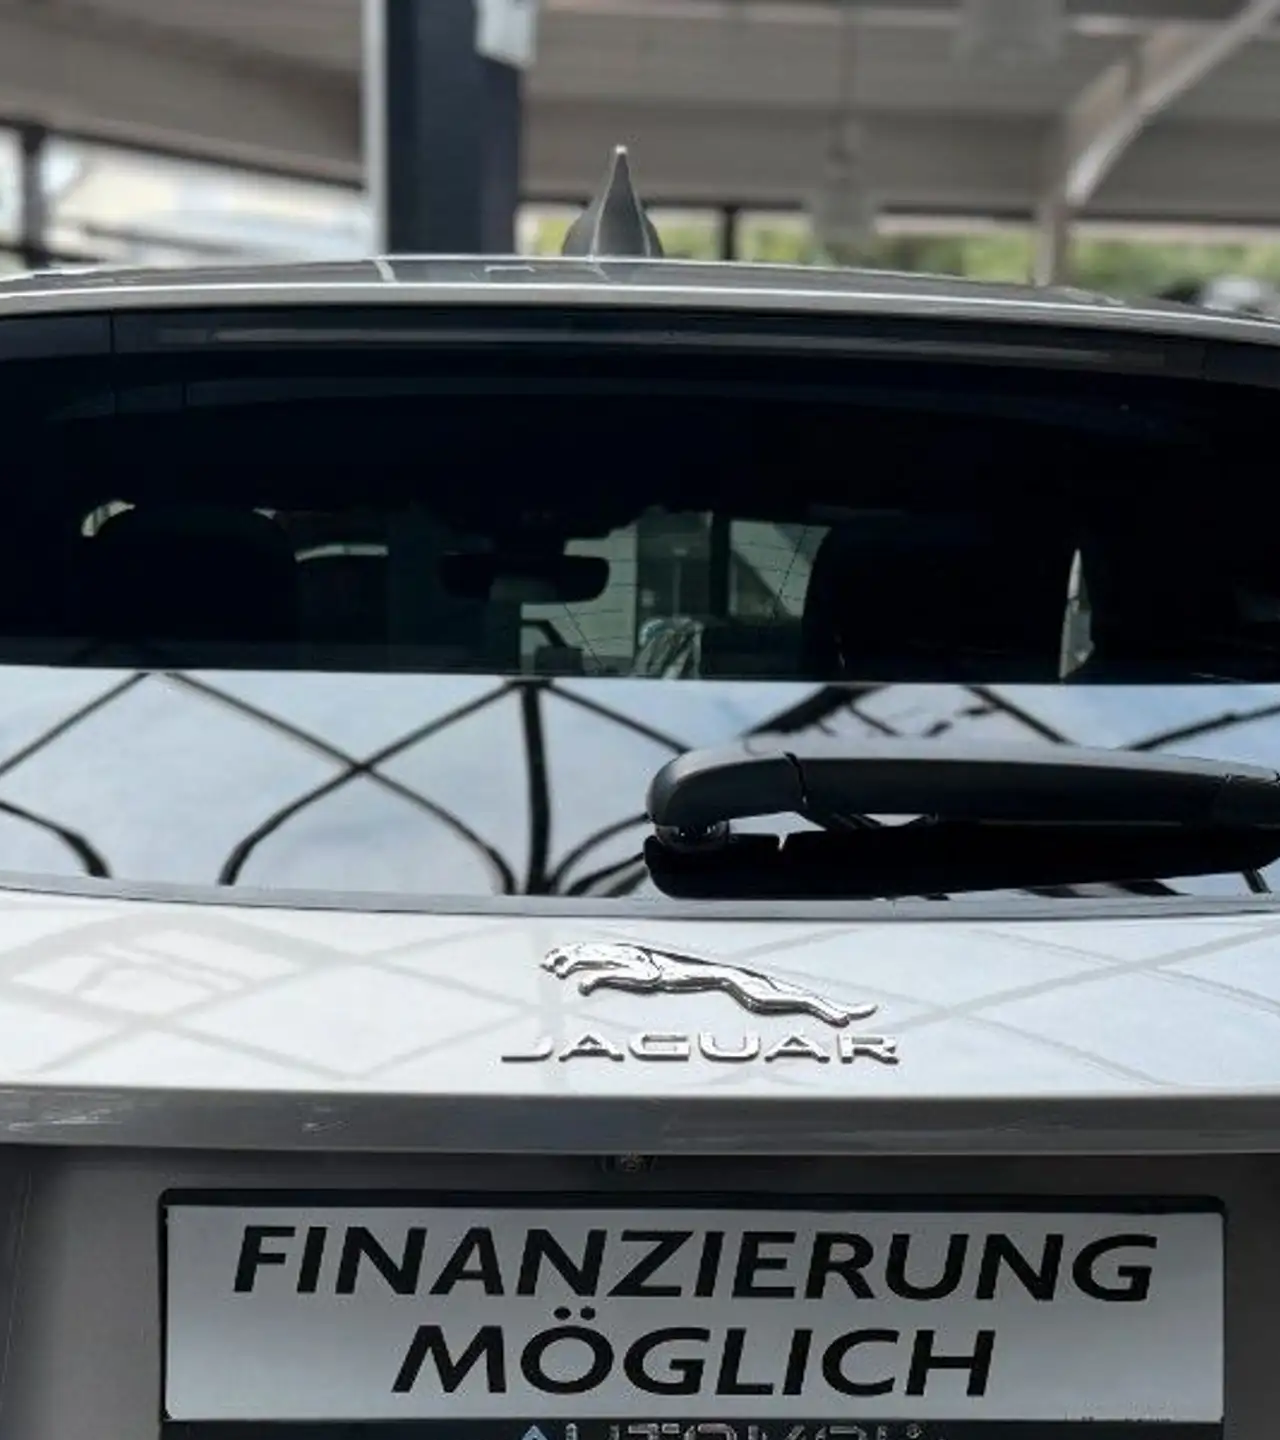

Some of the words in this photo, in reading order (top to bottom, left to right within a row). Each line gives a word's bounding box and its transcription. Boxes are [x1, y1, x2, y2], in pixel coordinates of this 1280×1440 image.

[501, 1033, 900, 1065] JAGUAR
[233, 1224, 1158, 1304] FINANZIERUNG
[391, 1305, 996, 1397] MÖGLICH
